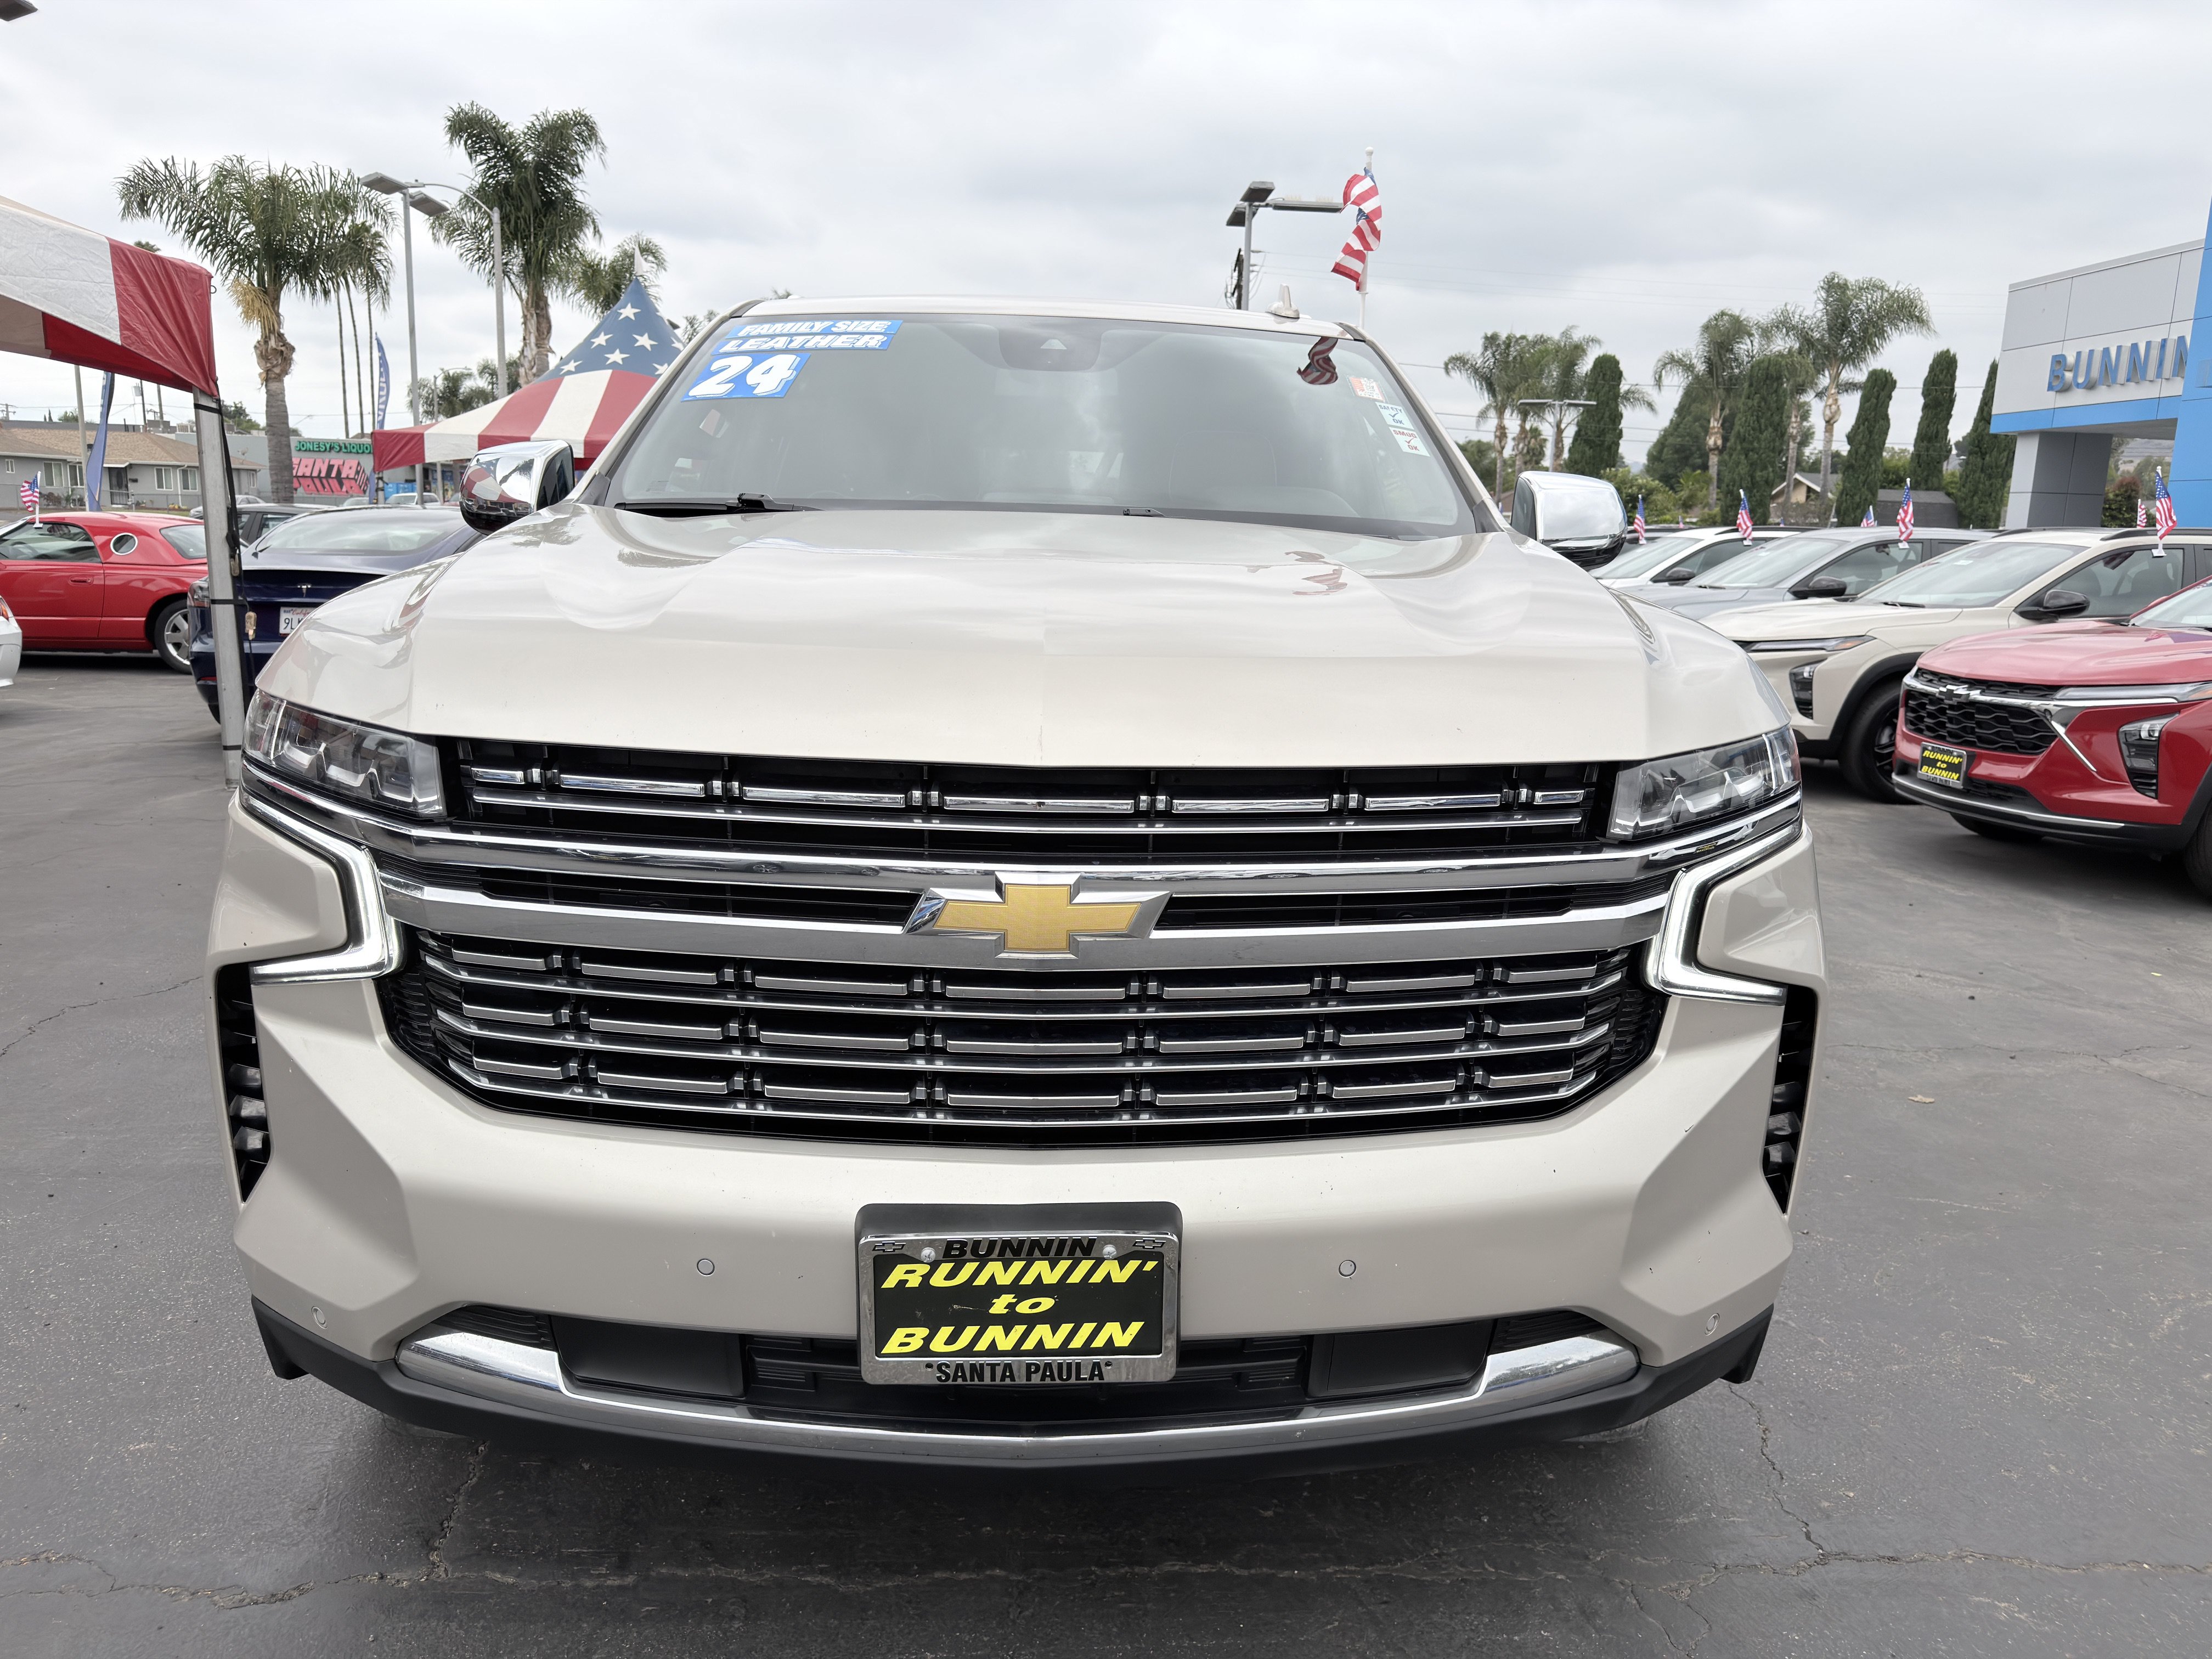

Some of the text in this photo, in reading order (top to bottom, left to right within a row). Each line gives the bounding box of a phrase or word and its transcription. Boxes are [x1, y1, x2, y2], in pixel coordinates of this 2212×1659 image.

[738, 320, 891, 336] FAMILY SIZE
[719, 335, 887, 352] LEATHER
[689, 354, 800, 398] 24
[1379, 404, 1403, 413] SAFETY
[295, 441, 340, 452] JONESY'S
[1922, 750, 1962, 764] RUNNIN'
[1921, 765, 1960, 780] BUNNIN
[943, 1237, 1097, 1259] BUNNIN
[881, 1260, 1159, 1288] RUNNIN'
[988, 1294, 1056, 1314] to
[881, 1321, 1146, 1354] BUNNIN
[936, 1359, 1105, 1383] SANTA PAULA
